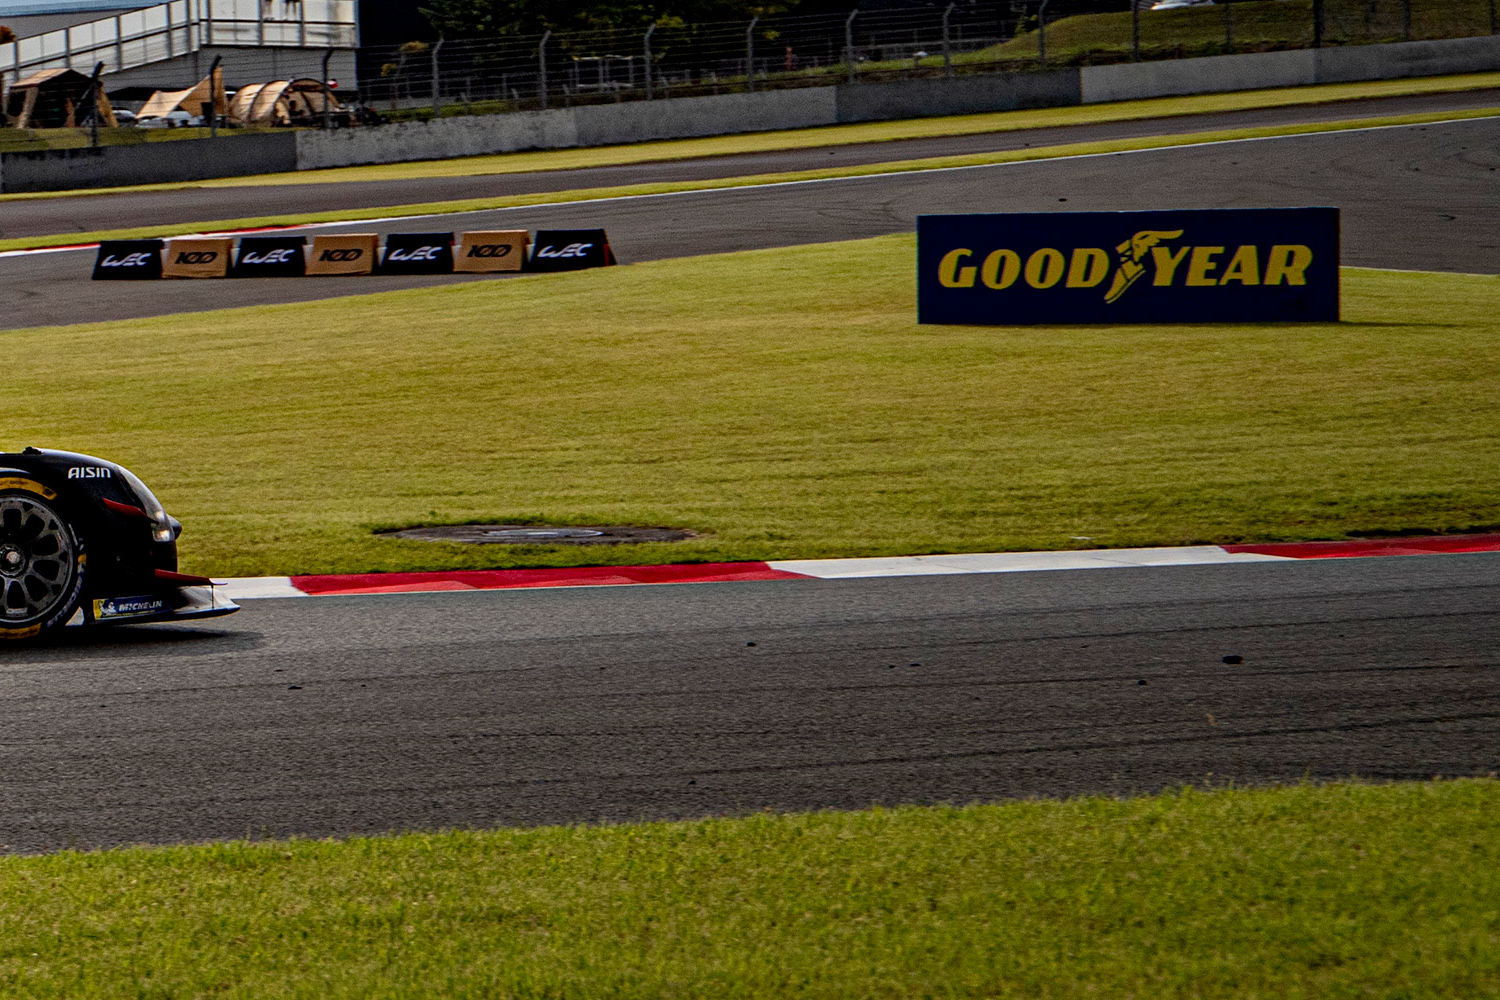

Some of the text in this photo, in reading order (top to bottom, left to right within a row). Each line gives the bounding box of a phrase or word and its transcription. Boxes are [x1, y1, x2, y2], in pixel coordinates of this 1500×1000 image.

[241, 249, 295, 264] WEC
[389, 246, 444, 261] WEC
[537, 243, 594, 258] WEC
[101, 252, 152, 267] WEC
[68, 466, 111, 479] AISIN
[118, 600, 163, 612] MICHELIN
